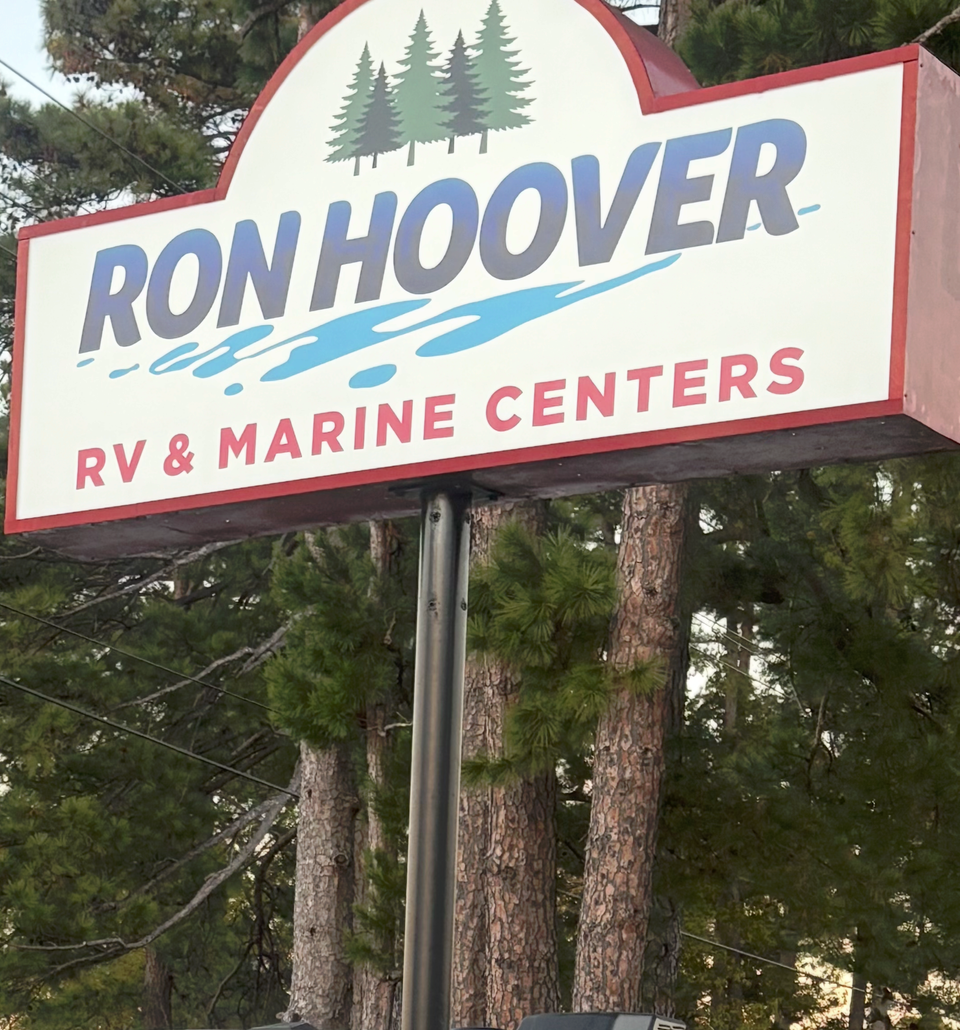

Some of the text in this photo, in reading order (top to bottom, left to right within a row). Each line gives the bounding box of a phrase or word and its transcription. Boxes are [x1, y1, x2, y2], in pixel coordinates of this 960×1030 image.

[80, 118, 808, 354] RON HOOVER
[76, 346, 806, 489] RV & MARINE CENTERS
